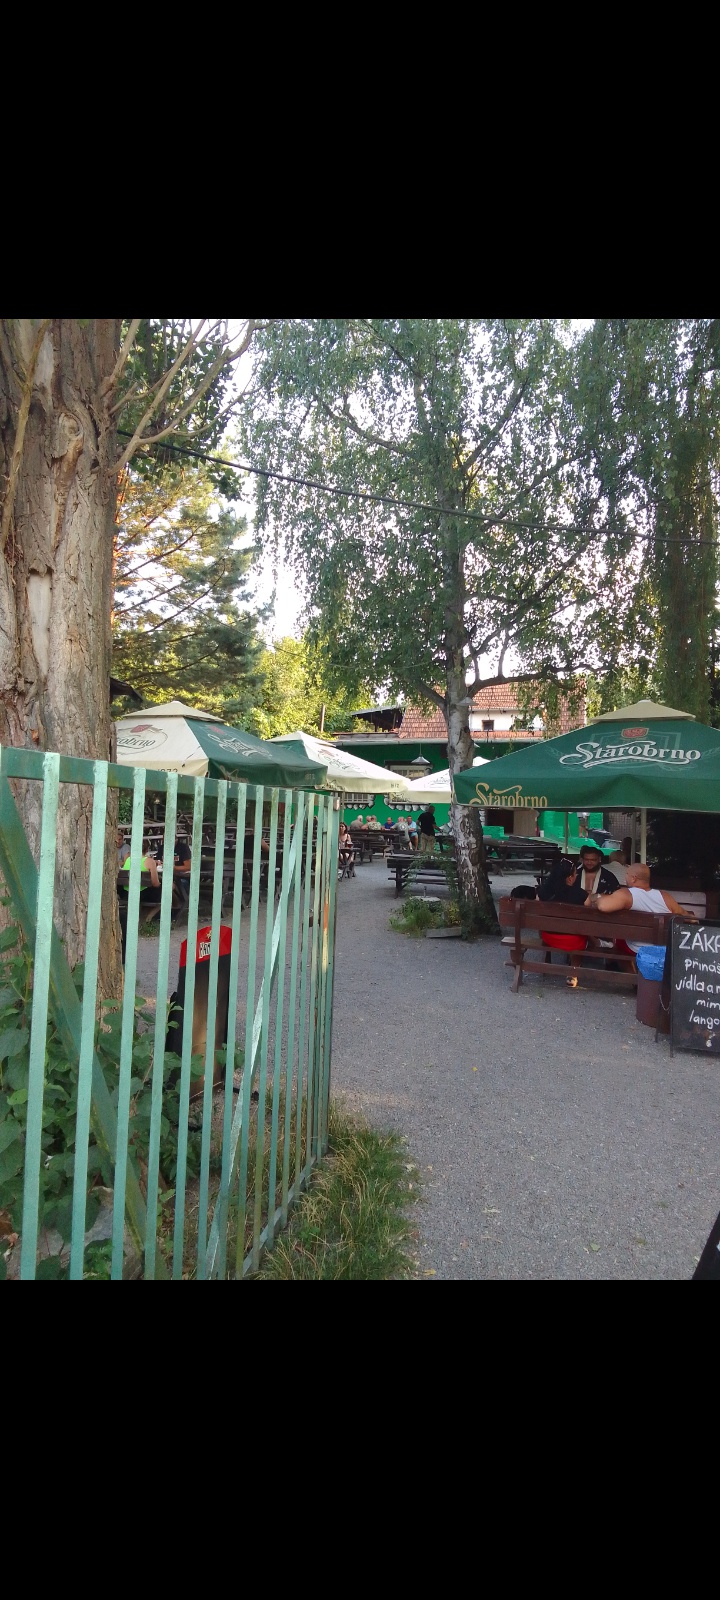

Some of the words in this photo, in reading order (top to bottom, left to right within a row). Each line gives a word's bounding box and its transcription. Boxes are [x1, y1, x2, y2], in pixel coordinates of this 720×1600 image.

[559, 740, 701, 768] Starobrno
[468, 782, 548, 808] Starobrno
[675, 973, 705, 993] jídla
